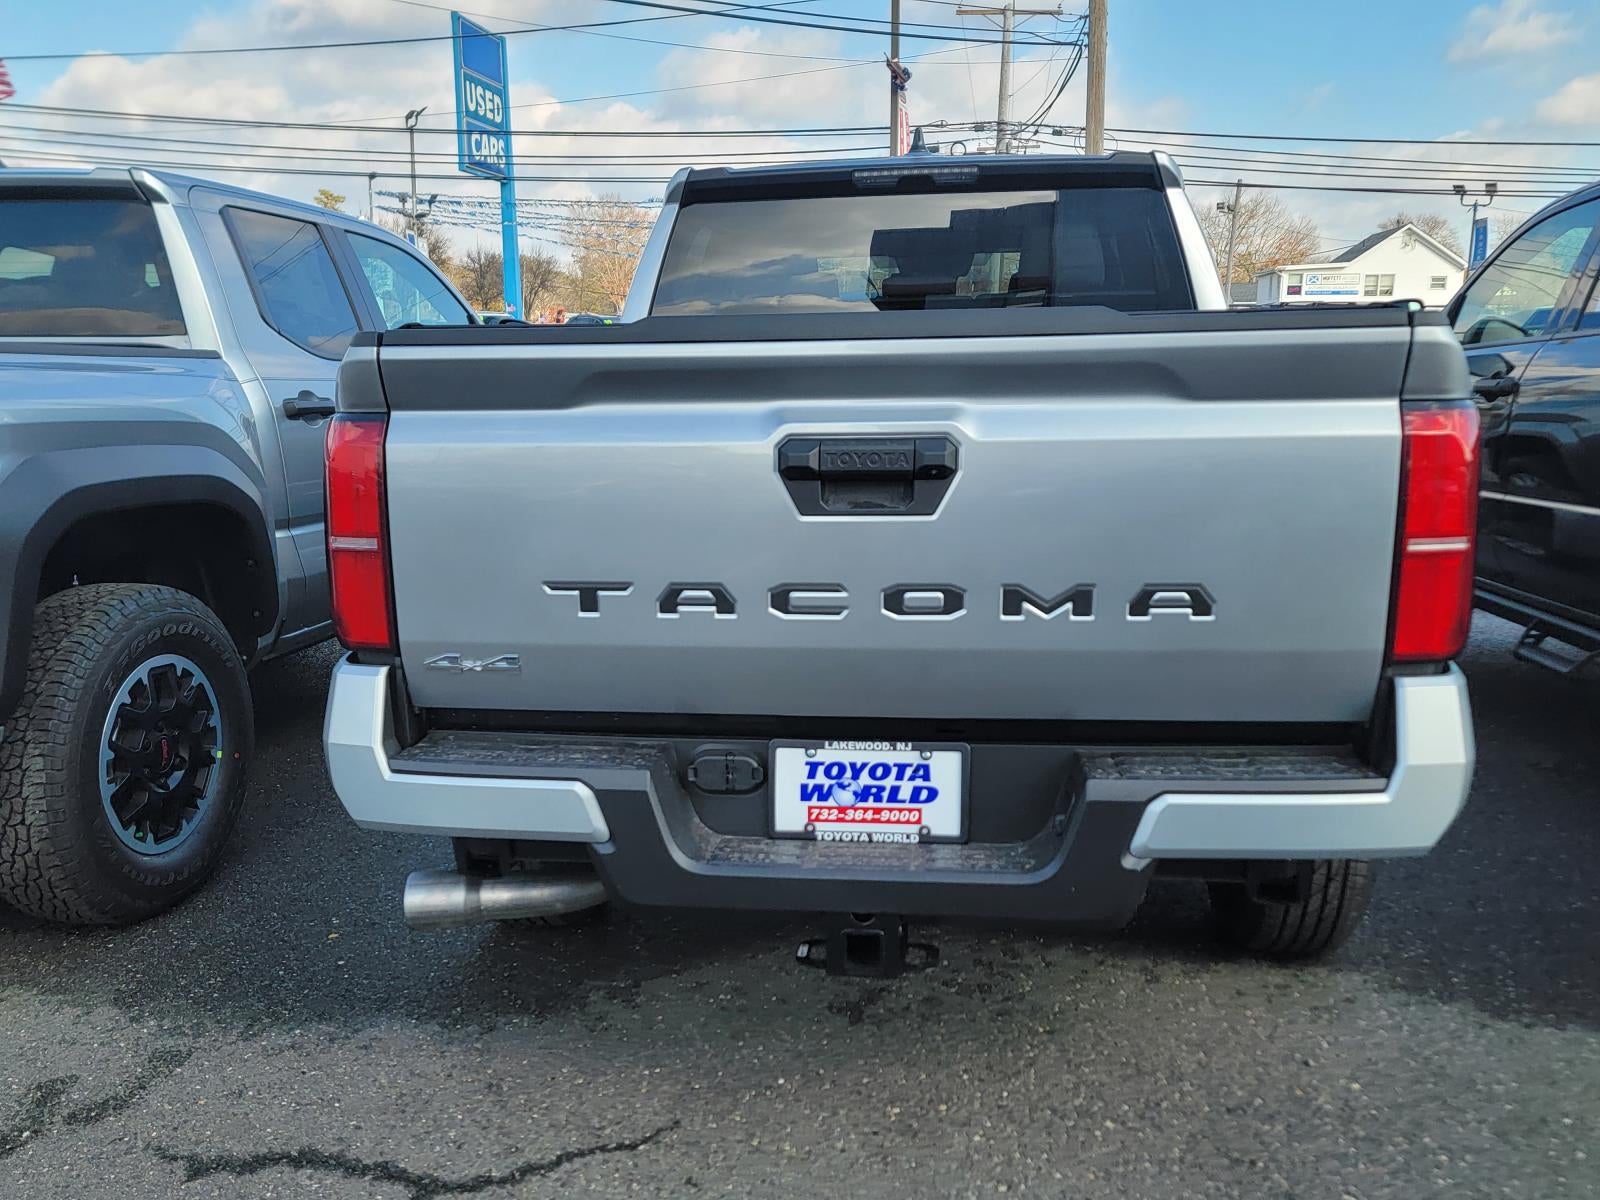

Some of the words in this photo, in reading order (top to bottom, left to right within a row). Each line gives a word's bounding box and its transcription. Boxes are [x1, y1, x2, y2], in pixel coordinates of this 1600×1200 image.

[465, 80, 503, 123] USED
[471, 131, 505, 168] CARS
[824, 452, 911, 469] TOYOTA
[542, 580, 1217, 621] TACOMA
[896, 742, 912, 751] NJ
[804, 761, 932, 782] TOYOTA
[810, 808, 920, 822] 732-364-9000
[816, 831, 870, 842] TOYOTA
[871, 832, 919, 843] WORLD
